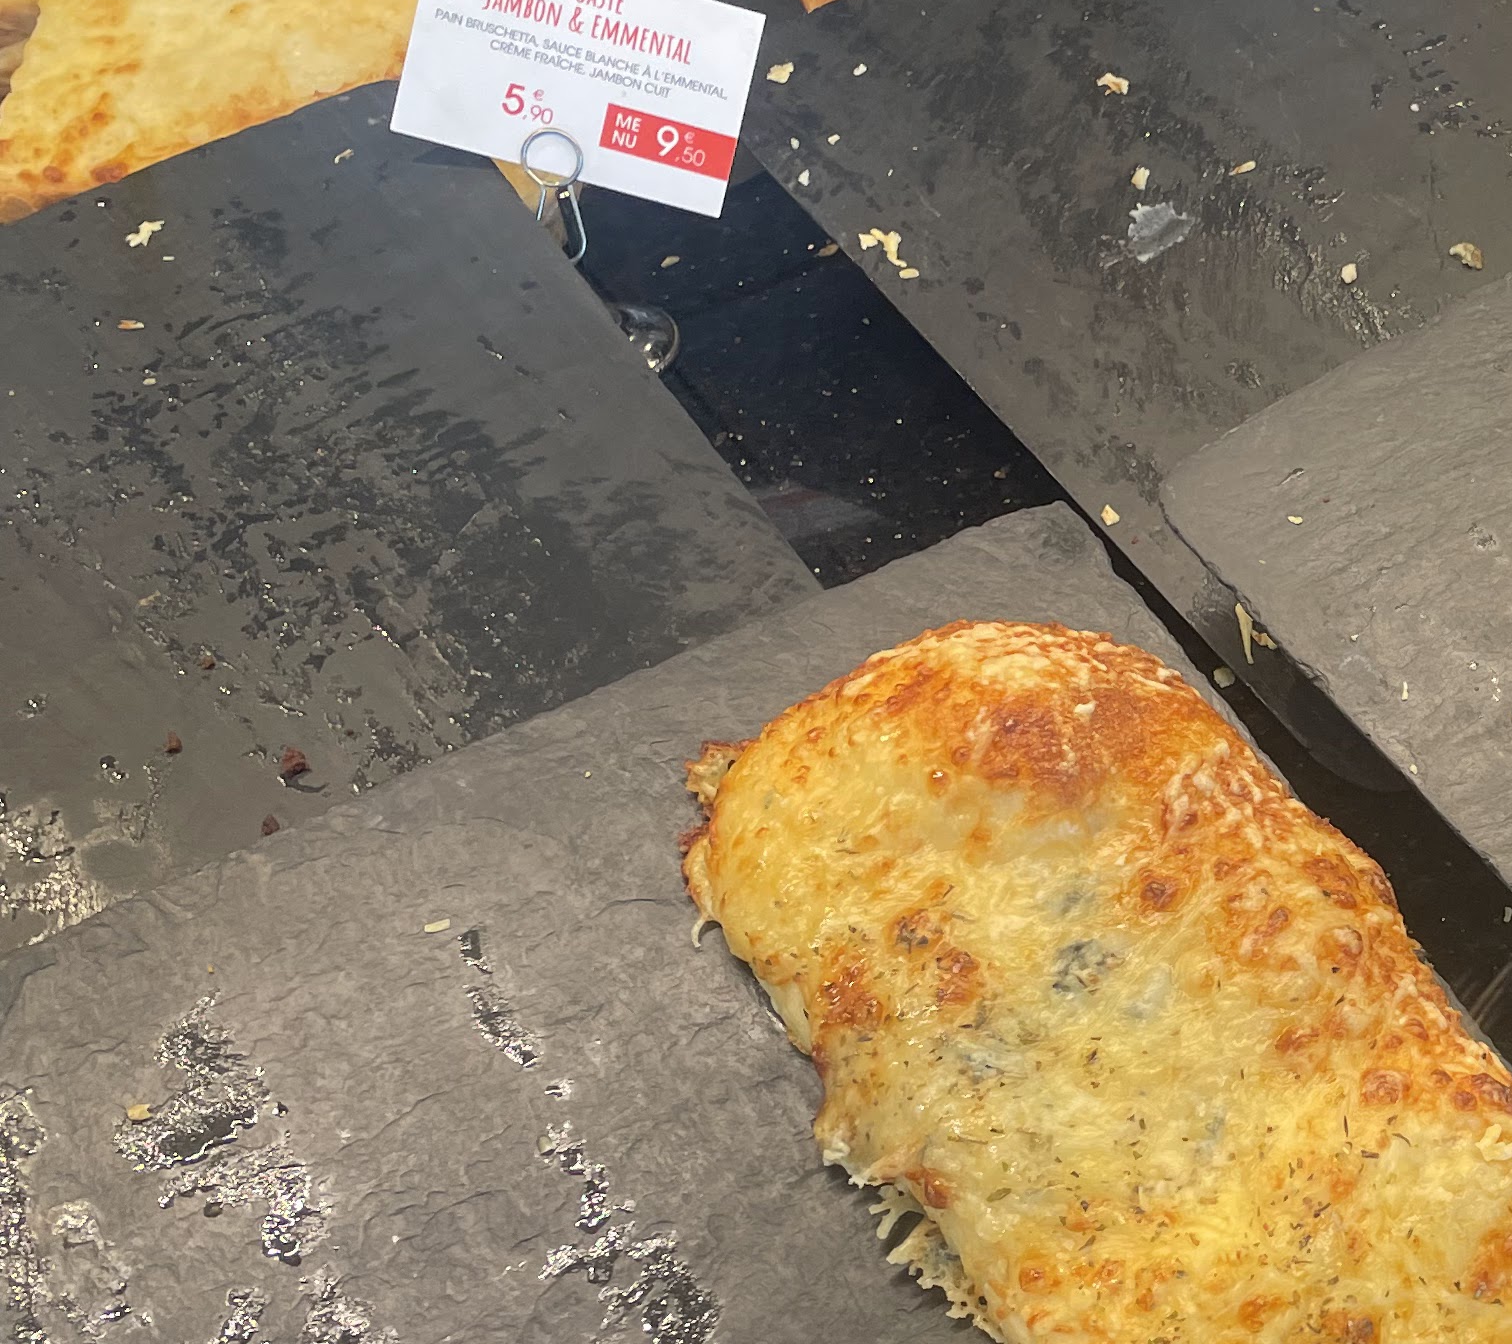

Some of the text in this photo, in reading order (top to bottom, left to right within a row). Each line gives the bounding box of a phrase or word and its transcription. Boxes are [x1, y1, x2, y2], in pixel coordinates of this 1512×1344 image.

[434, 7, 464, 26] PAIN
[542, 38, 583, 59] SAUCE
[584, 50, 640, 75] BLANCHE
[641, 64, 652, 79] À
[568, 6, 584, 35] &
[591, 15, 691, 65] EMMENTAL
[489, 39, 532, 60] CRÈME
[589, 67, 642, 90] JAMBON
[643, 82, 672, 99] CUIT
[611, 129, 638, 149] NU
[615, 112, 642, 133] ME
